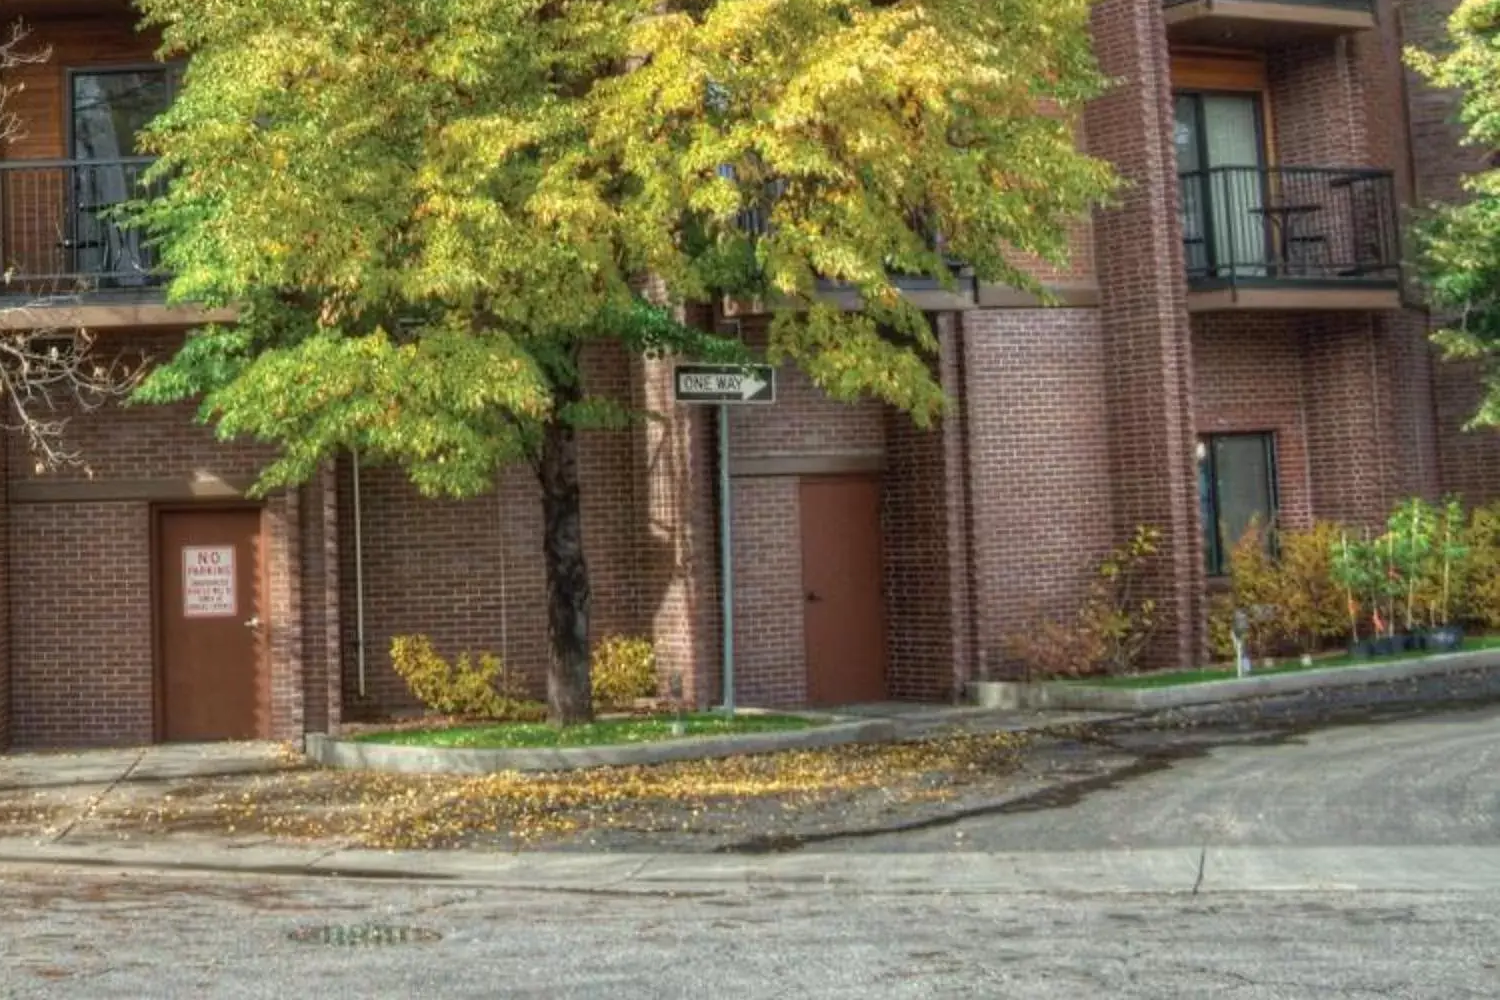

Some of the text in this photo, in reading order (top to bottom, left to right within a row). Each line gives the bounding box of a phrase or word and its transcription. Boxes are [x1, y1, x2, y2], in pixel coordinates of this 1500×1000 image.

[683, 375, 742, 391] ONE WAY
[197, 551, 221, 565] NO
[187, 566, 231, 576] PARKING
